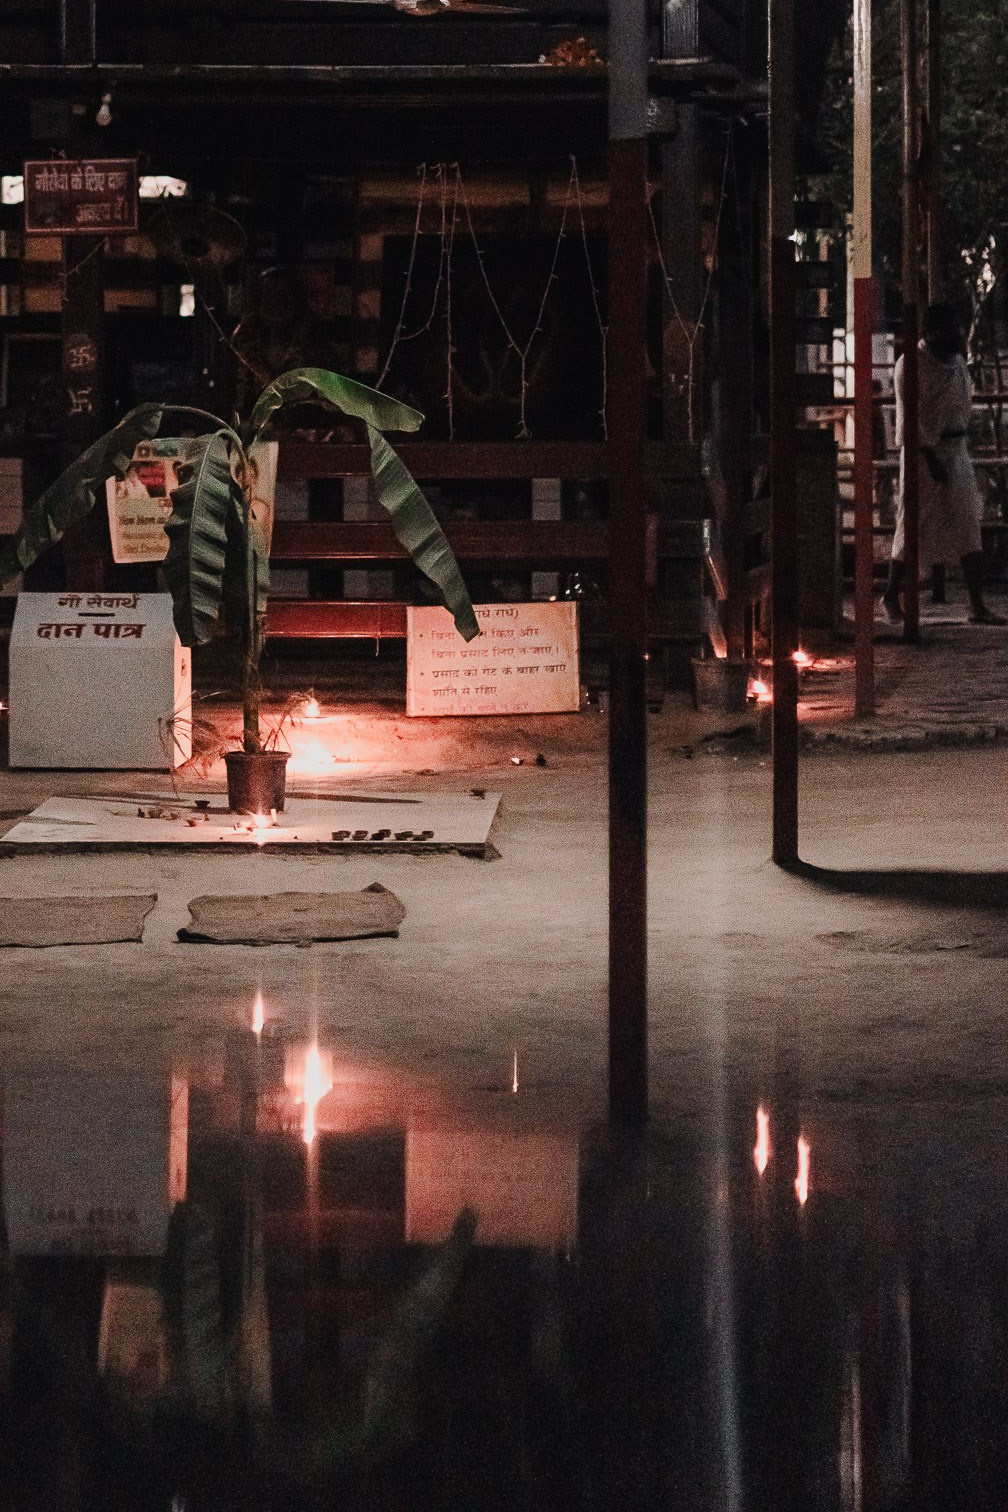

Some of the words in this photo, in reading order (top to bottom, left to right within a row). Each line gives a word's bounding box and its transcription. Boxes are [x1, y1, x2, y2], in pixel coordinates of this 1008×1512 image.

[86, 593, 141, 610] सेवार्थ
[37, 623, 87, 639] दान
[92, 623, 147, 639] पात्र
